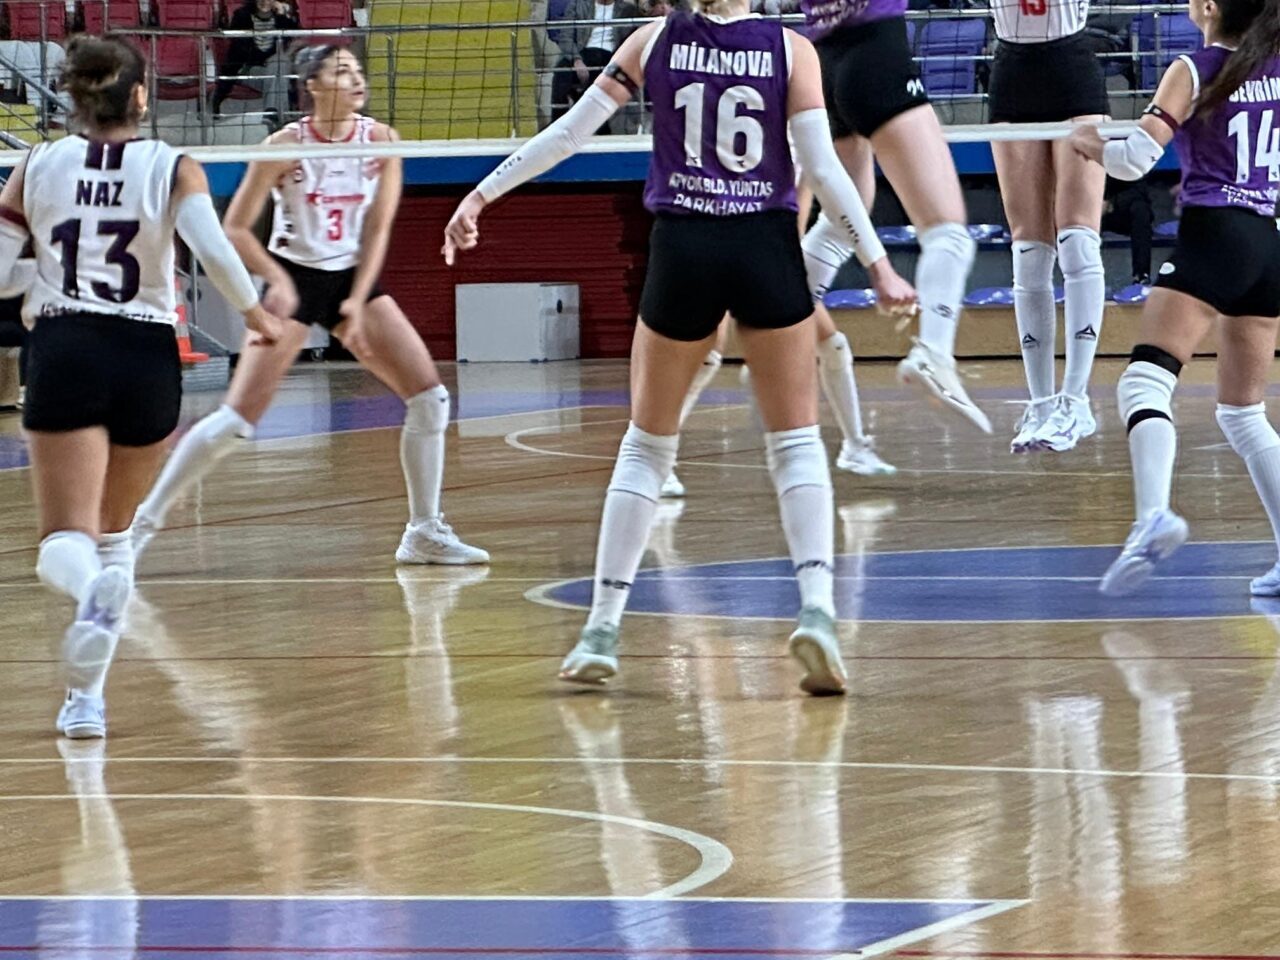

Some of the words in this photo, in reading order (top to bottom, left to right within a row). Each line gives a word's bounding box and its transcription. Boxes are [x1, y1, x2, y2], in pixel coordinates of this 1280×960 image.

[670, 41, 774, 77] MİLANOVA
[674, 82, 765, 173] 16
[75, 180, 124, 206] NAZ
[327, 209, 343, 240] 3
[51, 218, 140, 303] 13
